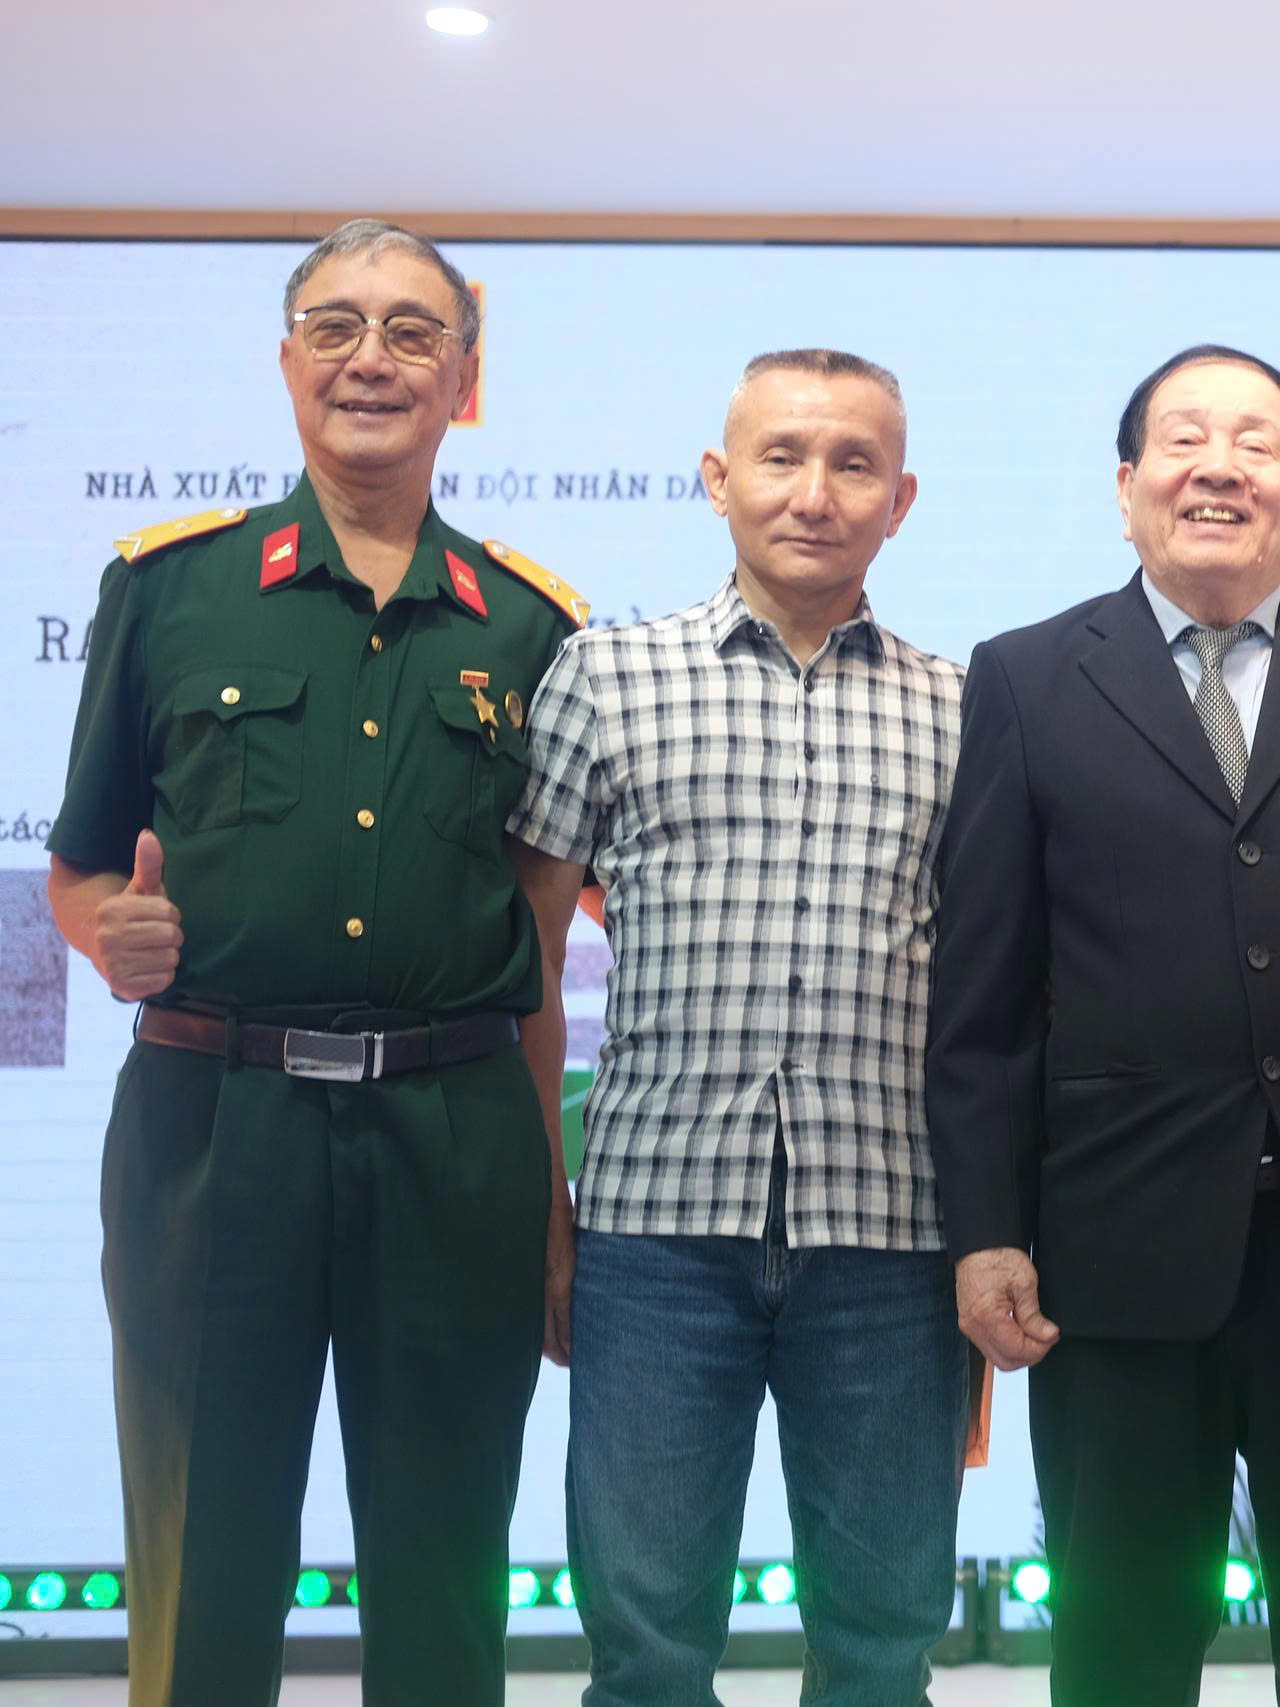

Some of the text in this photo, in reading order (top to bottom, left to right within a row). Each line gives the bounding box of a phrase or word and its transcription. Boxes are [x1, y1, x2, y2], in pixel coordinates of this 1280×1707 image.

[85, 464, 158, 499] NHÀ
[173, 463, 267, 499] XUẤT
[476, 467, 538, 507] ĐỘI
[554, 468, 649, 500] NHÂN
[665, 468, 707, 500] DÂ
